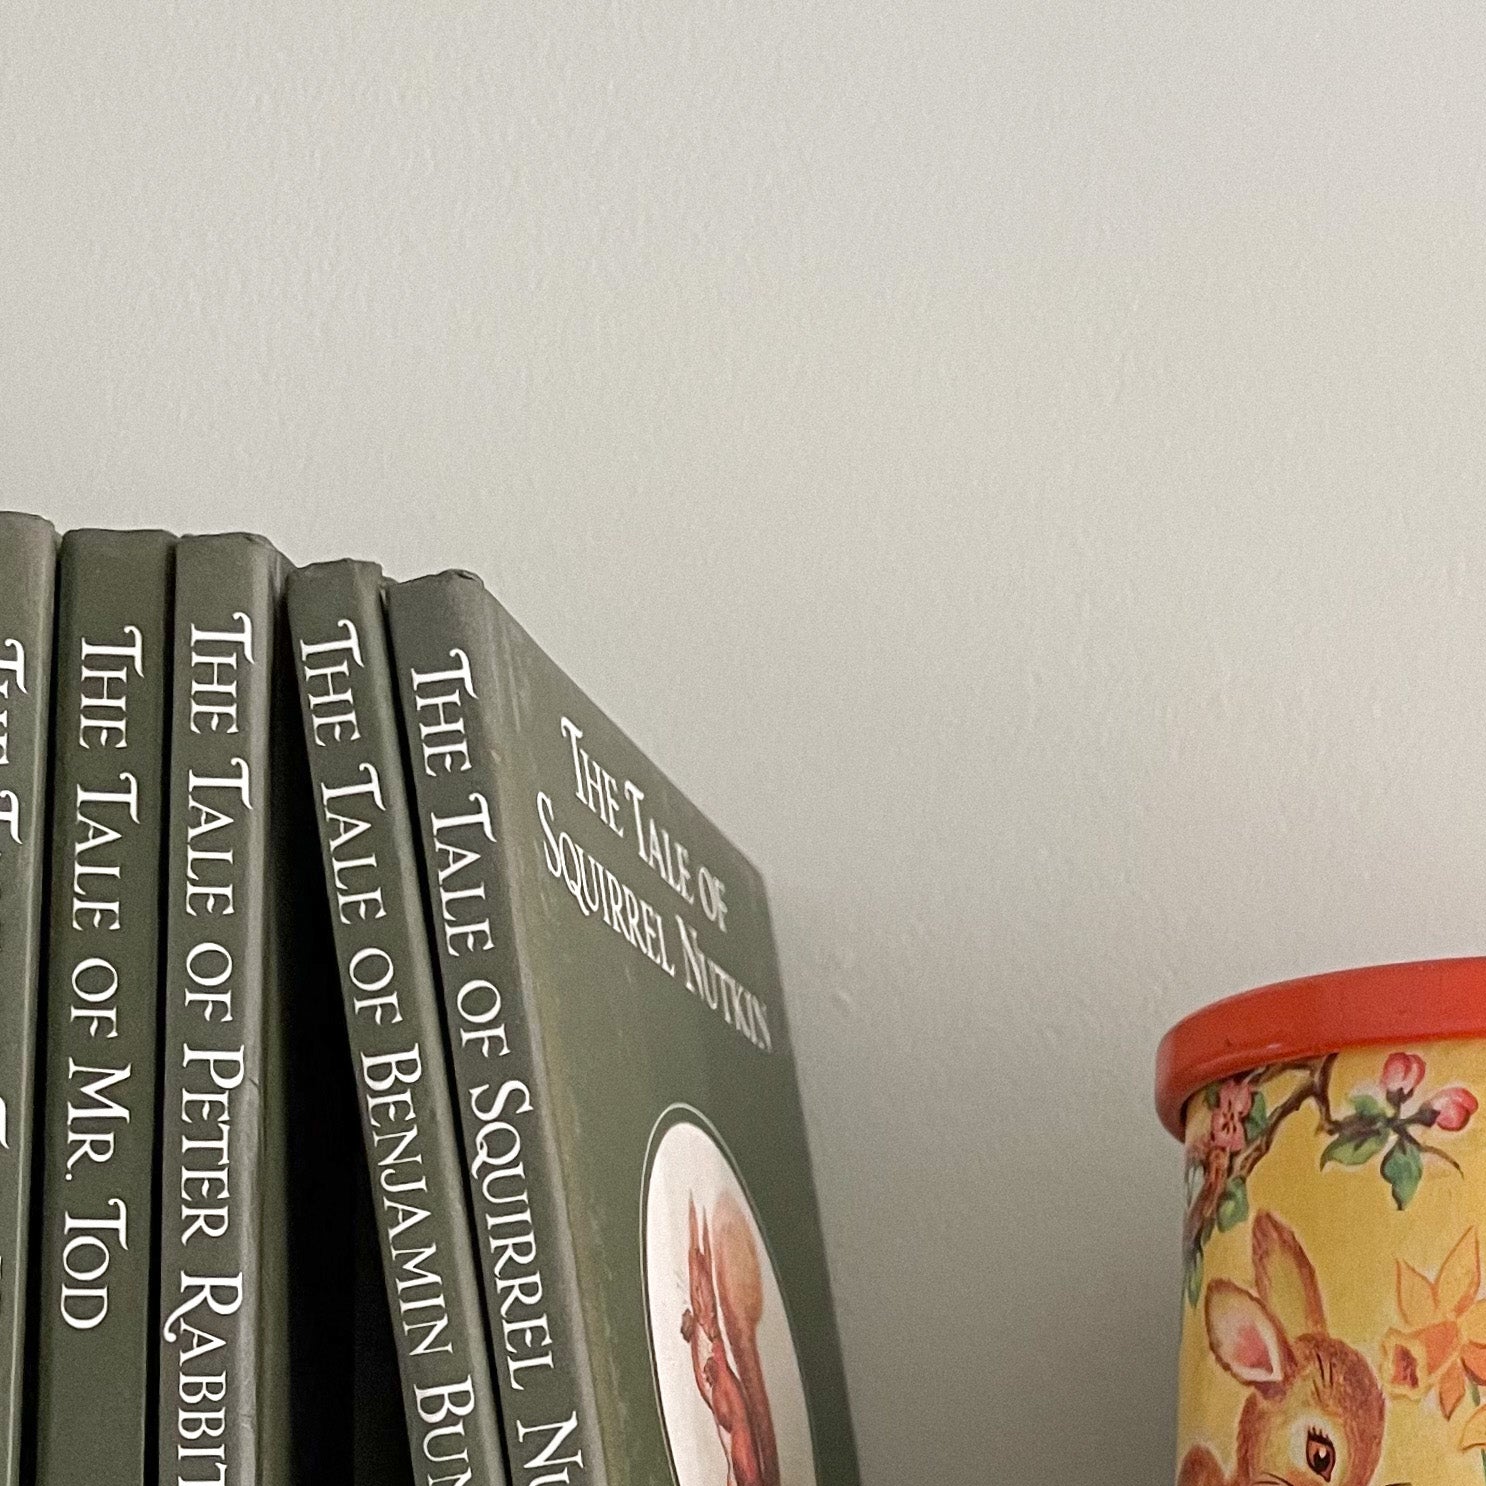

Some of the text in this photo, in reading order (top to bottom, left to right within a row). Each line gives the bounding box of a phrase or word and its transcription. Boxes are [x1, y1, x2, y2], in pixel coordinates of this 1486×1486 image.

[189, 611, 256, 735] THE
[299, 620, 365, 747] THE
[410, 647, 480, 777] THE
[185, 756, 253, 917] TALE
[320, 762, 387, 925] TALE
[430, 792, 498, 957] TALE
[560, 715, 728, 933] THE TALE OF
[60, 625, 145, 1329] THE TALE OF MR. TOD
[184, 942, 234, 1023] OF
[349, 947, 404, 1026] OF
[533, 790, 772, 1051] SQUIRREL NUTKIN
[456, 979, 511, 1058] OF
[180, 1042, 247, 1246] PETER
[360, 1042, 454, 1356] BENJAMIN
[469, 1079, 555, 1391] SQUIRREL
